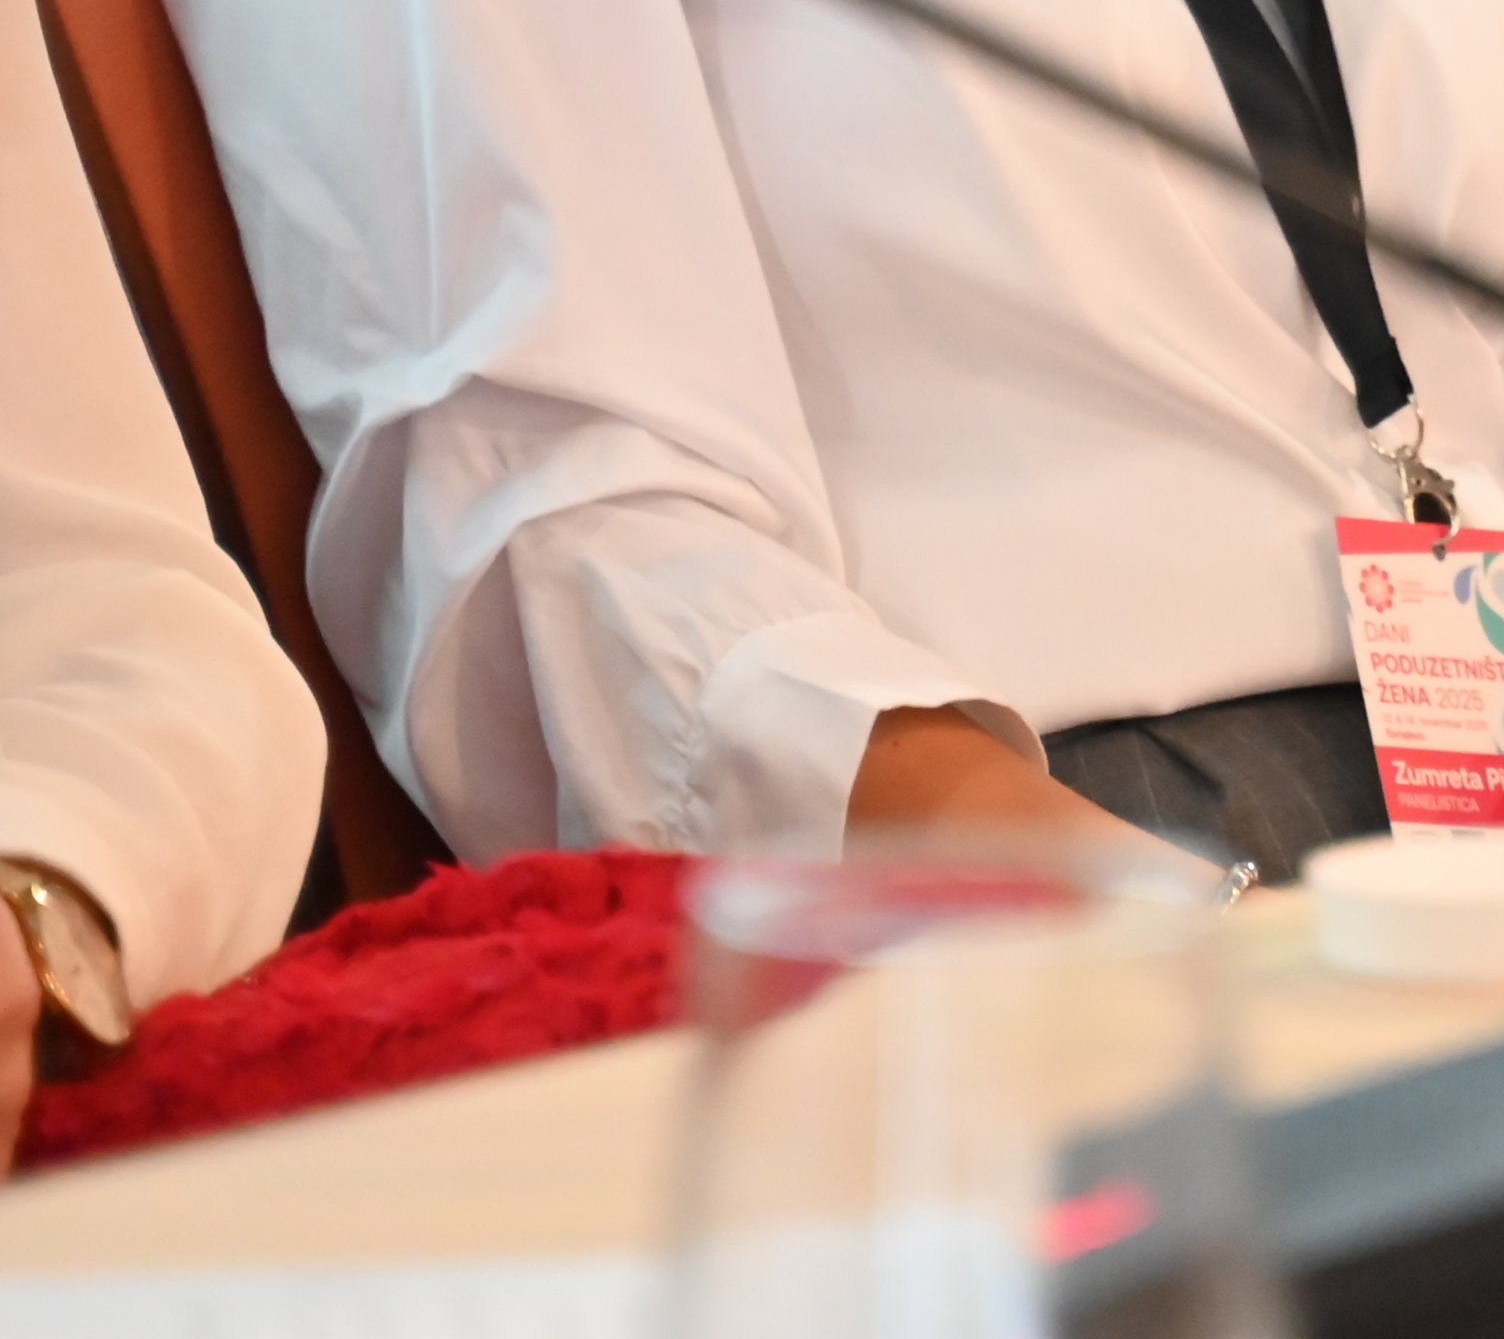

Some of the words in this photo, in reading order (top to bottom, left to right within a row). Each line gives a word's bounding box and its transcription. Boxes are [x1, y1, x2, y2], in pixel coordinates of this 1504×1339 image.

[1364, 621, 1410, 644] DANI
[1377, 678, 1431, 707] ŽENA
[1434, 687, 1485, 711] 2025
[1392, 760, 1484, 790] Zumreta
